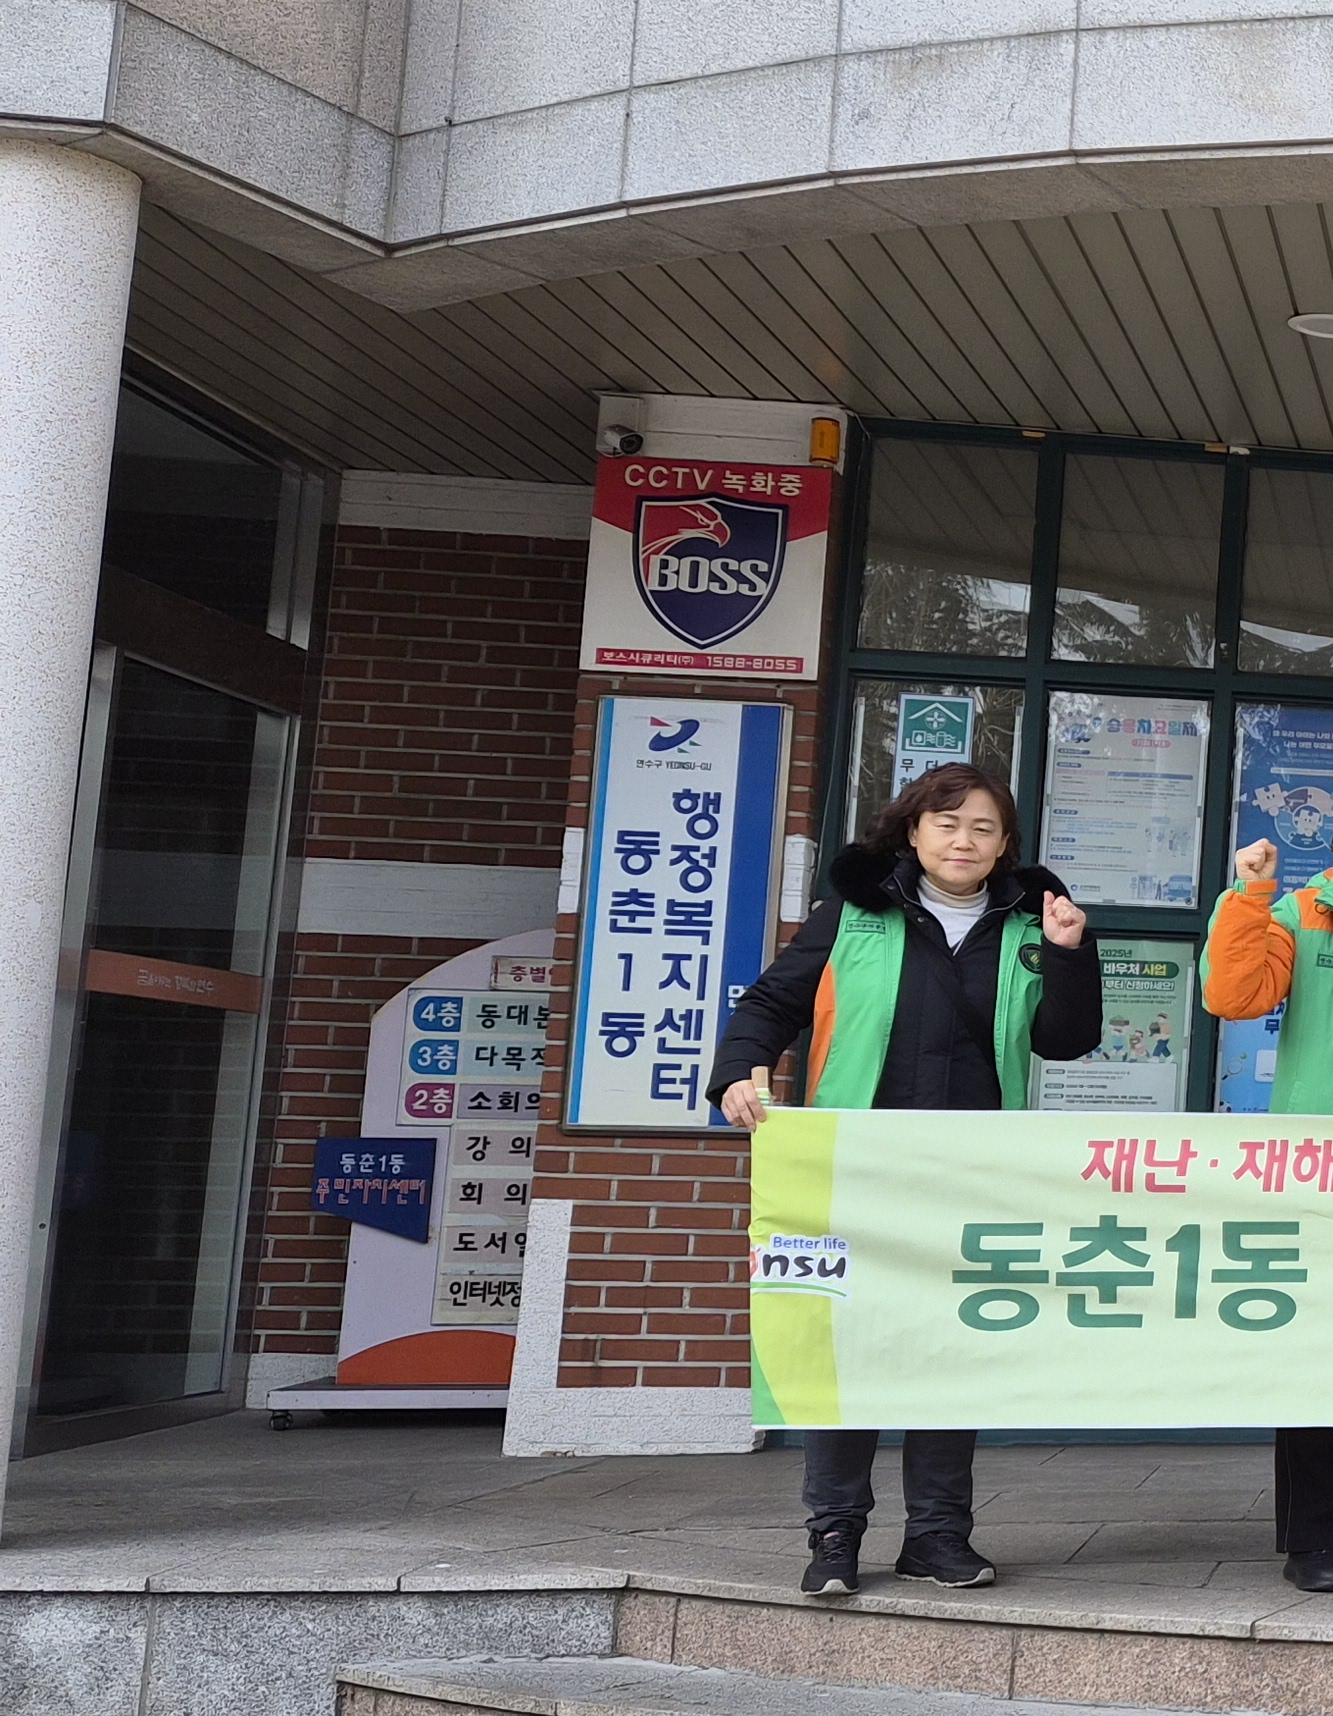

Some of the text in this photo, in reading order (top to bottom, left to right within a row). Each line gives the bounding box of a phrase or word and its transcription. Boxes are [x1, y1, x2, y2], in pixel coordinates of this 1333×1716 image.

[624, 464, 803, 496] CCTV 녹화중
[648, 555, 769, 596] BOSS
[602, 651, 797, 671] 보스시큐리티(주) 1588-8055
[636, 759, 712, 771] 연수구 YEONSU-GU
[599, 830, 661, 1058] 동춘1동
[650, 788, 722, 1110] 행정복지센터
[1100, 949, 1133, 958] 2025년
[509, 965, 553, 984] 층별
[1103, 962, 1167, 976] 바우처 사업
[1102, 979, 1124, 990] 부터
[420, 1002, 460, 1028] 4층
[417, 1045, 457, 1071] 3층
[412, 1088, 452, 1114] 2층
[340, 1153, 406, 1174] 동춘1동
[315, 1178, 427, 1205] 주민자치센터
[773, 1236, 847, 1250] Better life
[951, 1214, 1309, 1332] 동춘1동
